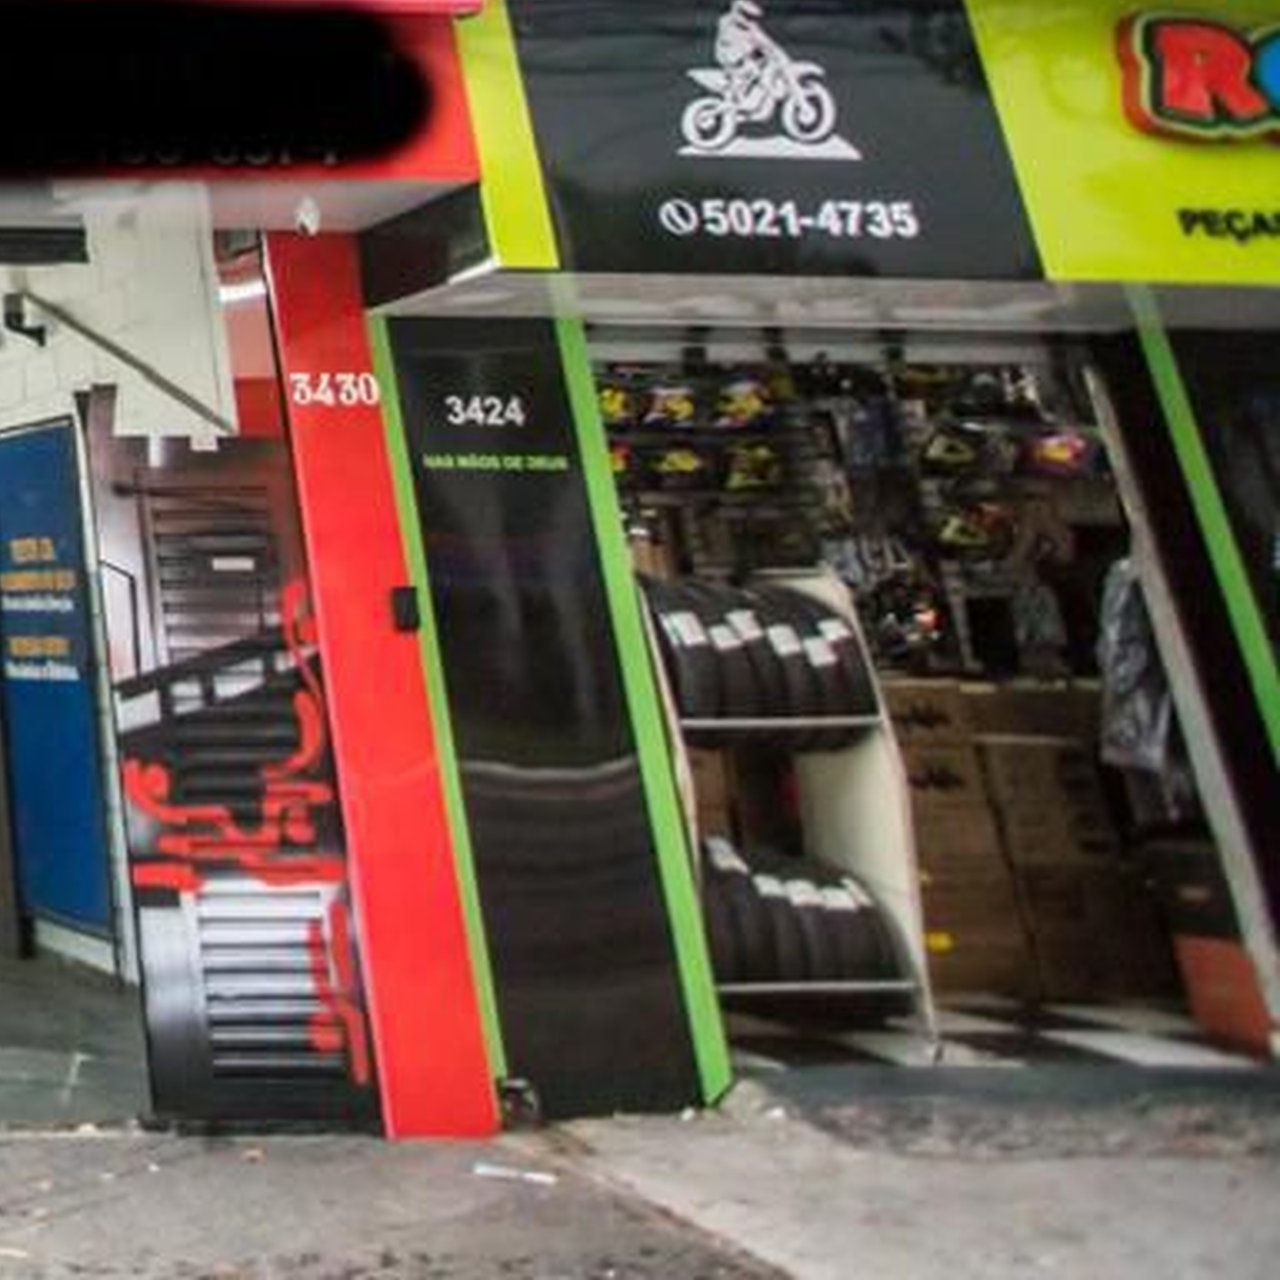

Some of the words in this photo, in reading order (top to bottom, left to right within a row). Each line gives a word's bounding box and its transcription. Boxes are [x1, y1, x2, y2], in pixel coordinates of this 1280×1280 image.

[1132, 12, 1280, 134] R
[701, 198, 919, 238] 5021-4735
[290, 372, 380, 406] 3430
[444, 395, 525, 427] 3424
